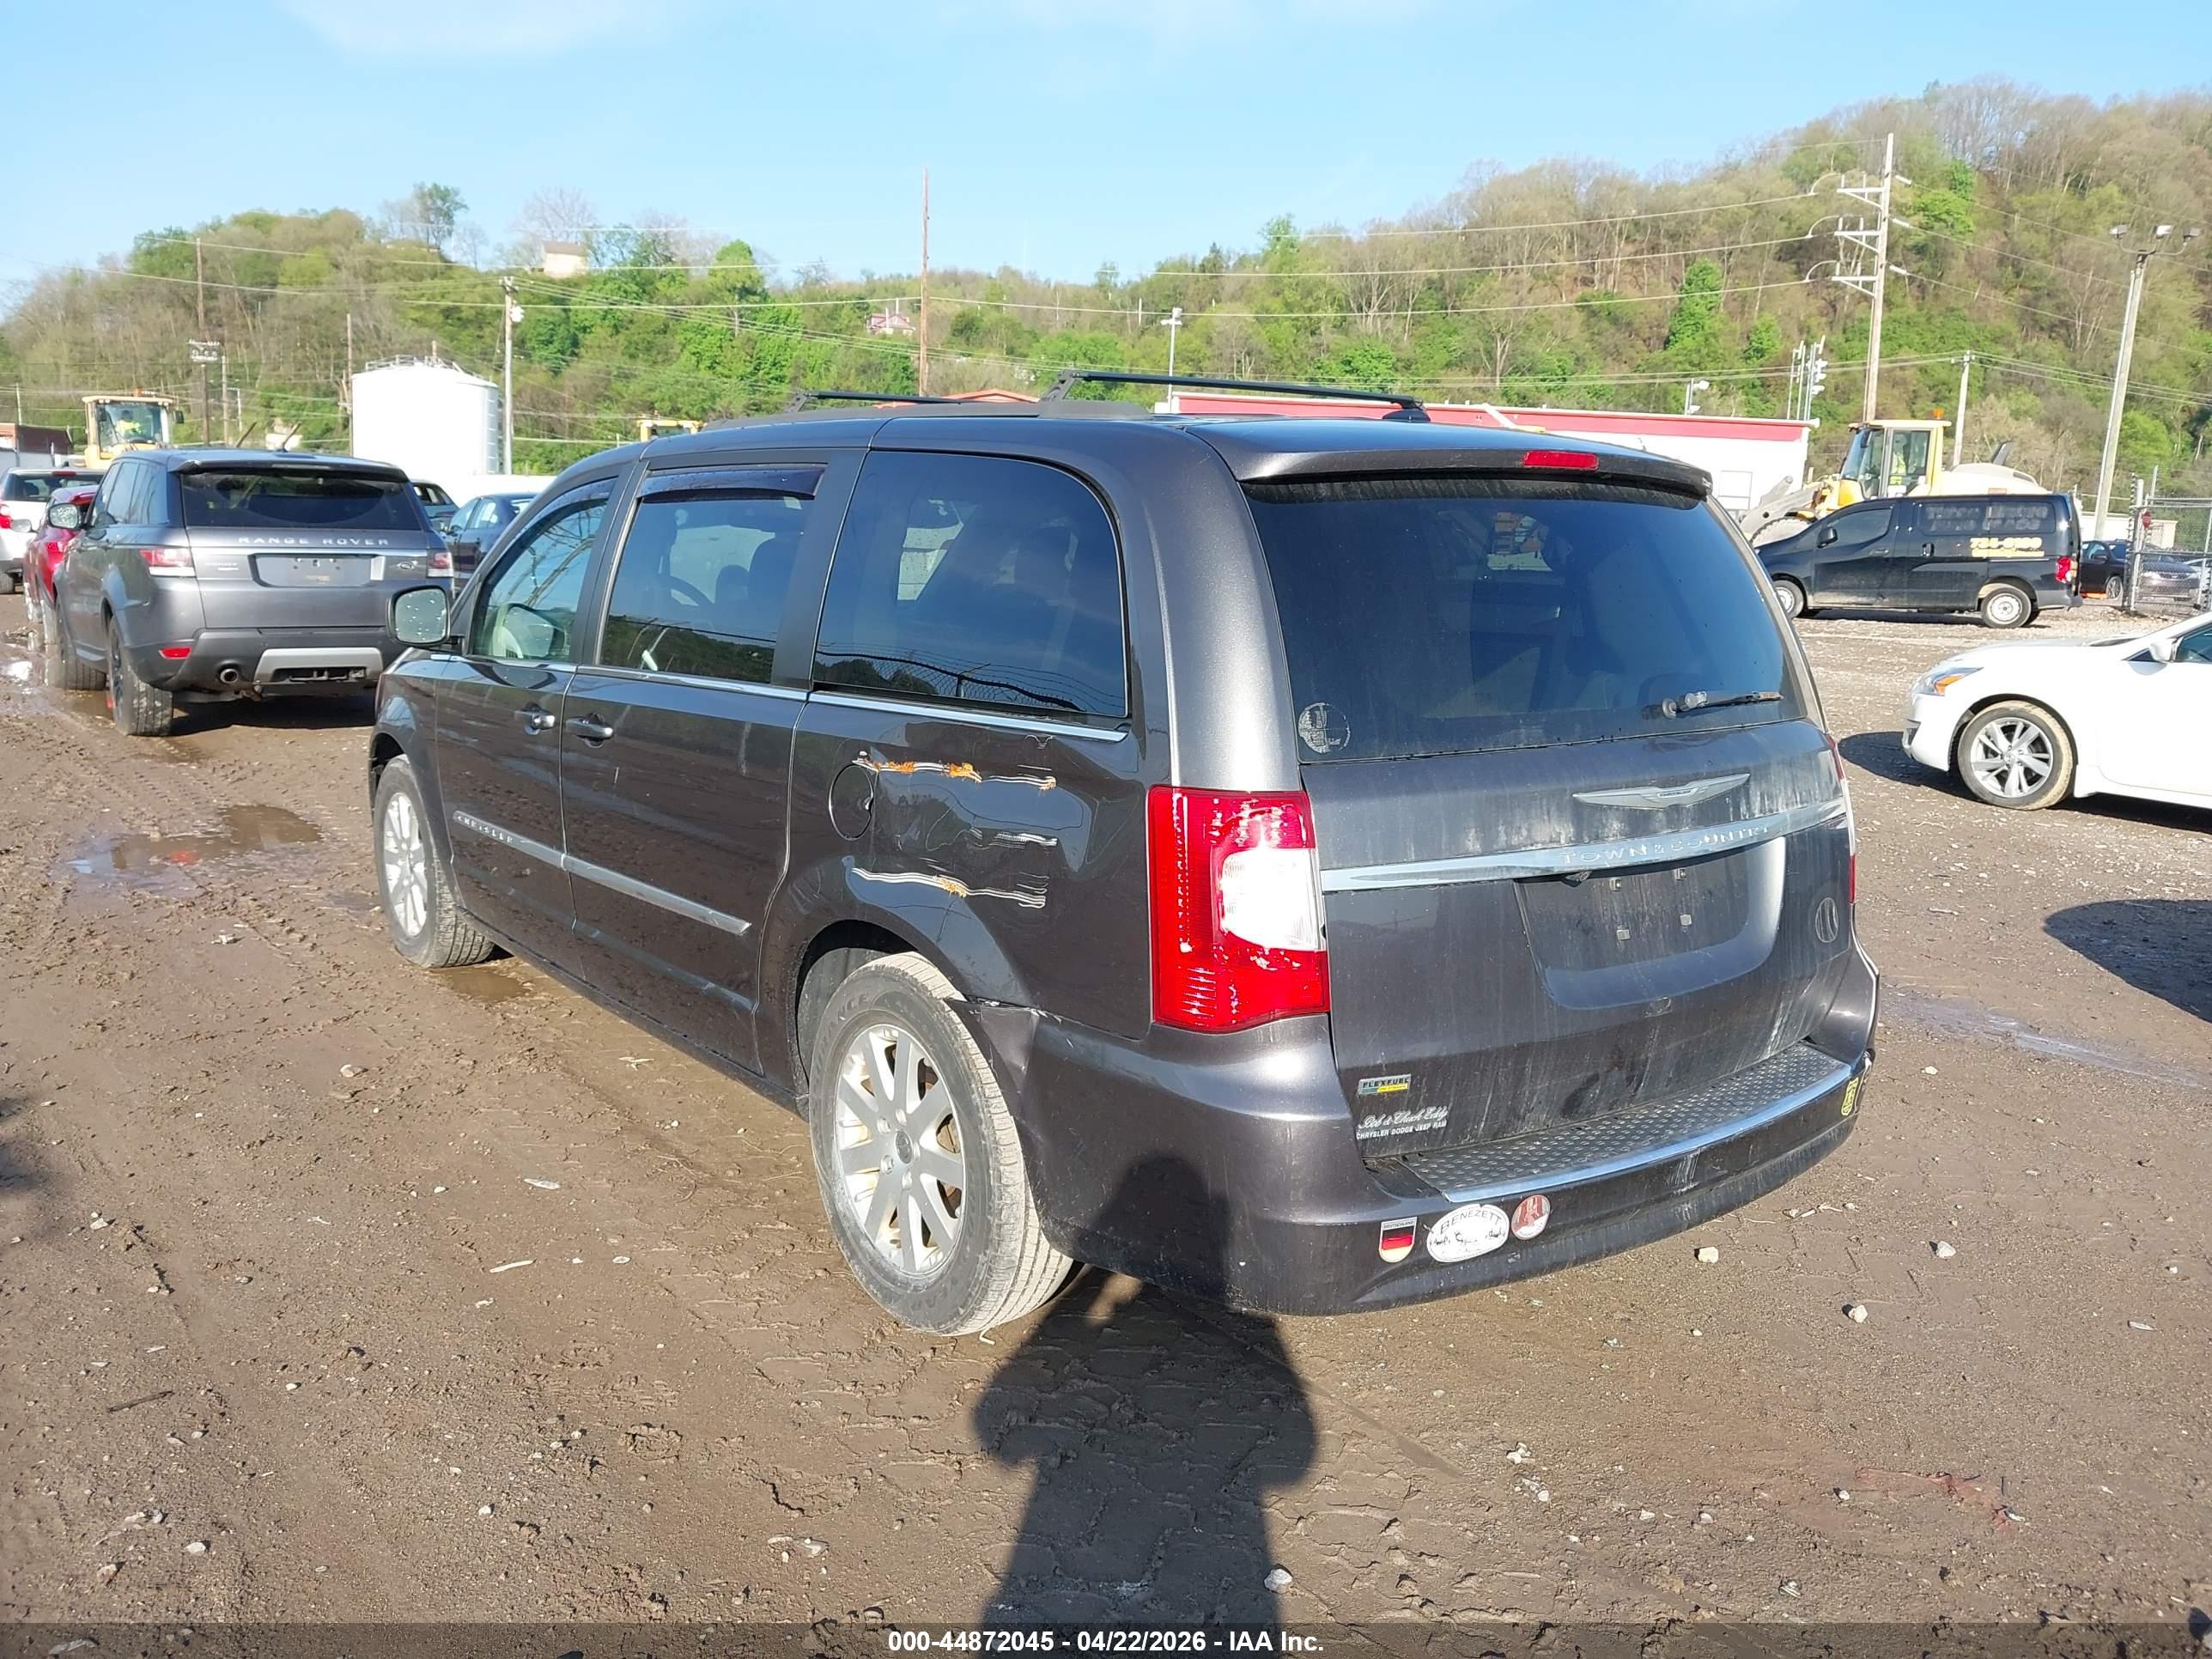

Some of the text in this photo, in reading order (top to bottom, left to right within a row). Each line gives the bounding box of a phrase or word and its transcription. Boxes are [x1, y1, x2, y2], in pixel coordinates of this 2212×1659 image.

[1559, 843, 1648, 865] TOWN
[1670, 825, 1770, 852] COUNTRY
[1362, 1077, 1409, 1089] FLEXFUEL
[1356, 1129, 1389, 1140] CHRYSLER
[1391, 1126, 1414, 1135] DODGE
[1415, 1122, 1431, 1132] JEEP
[1440, 1209, 1502, 1234] BENEZETT
